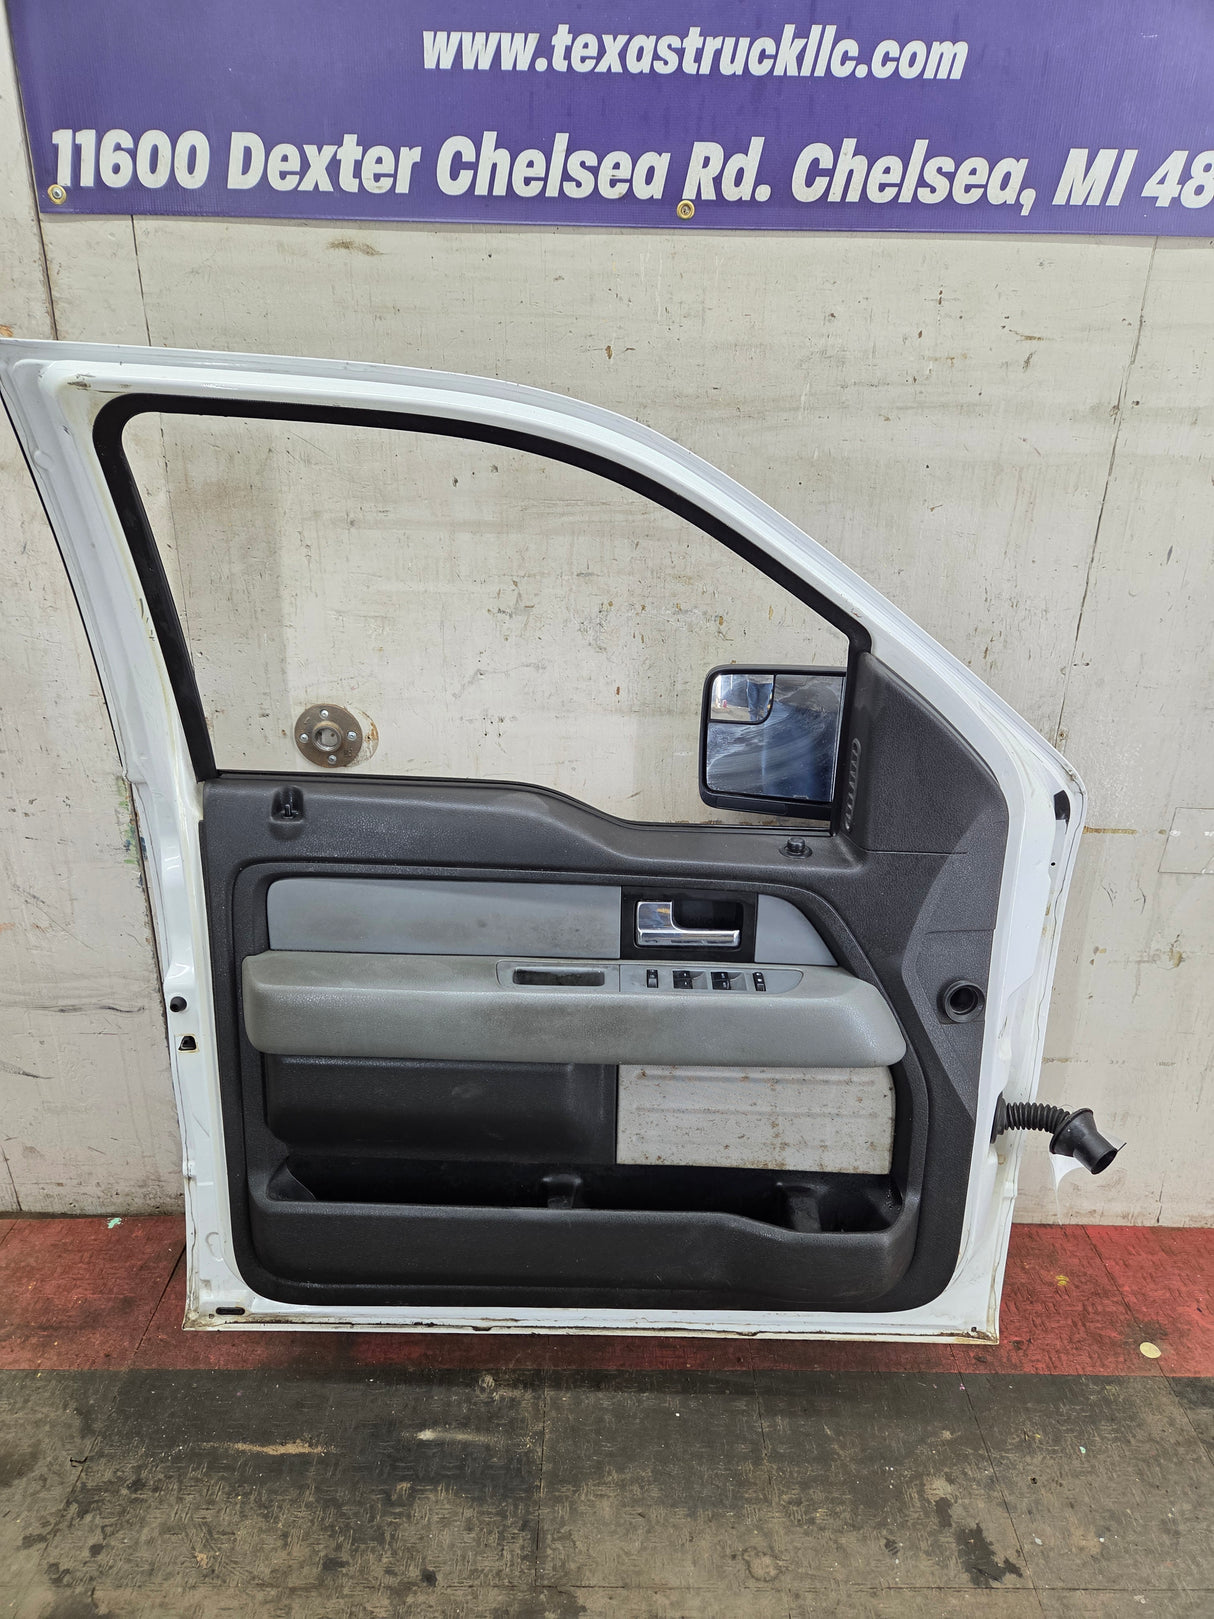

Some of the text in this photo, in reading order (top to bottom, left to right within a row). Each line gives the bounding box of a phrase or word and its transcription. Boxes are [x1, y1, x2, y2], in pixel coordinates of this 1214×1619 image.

[422, 23, 970, 80] www.texastruckllc.com
[51, 128, 211, 190] 11600
[226, 131, 422, 195] Dexter
[436, 130, 672, 200] Chelsea
[681, 136, 772, 203] Rd.
[791, 138, 1037, 216] Chelsea,
[1052, 147, 1139, 208] MI
